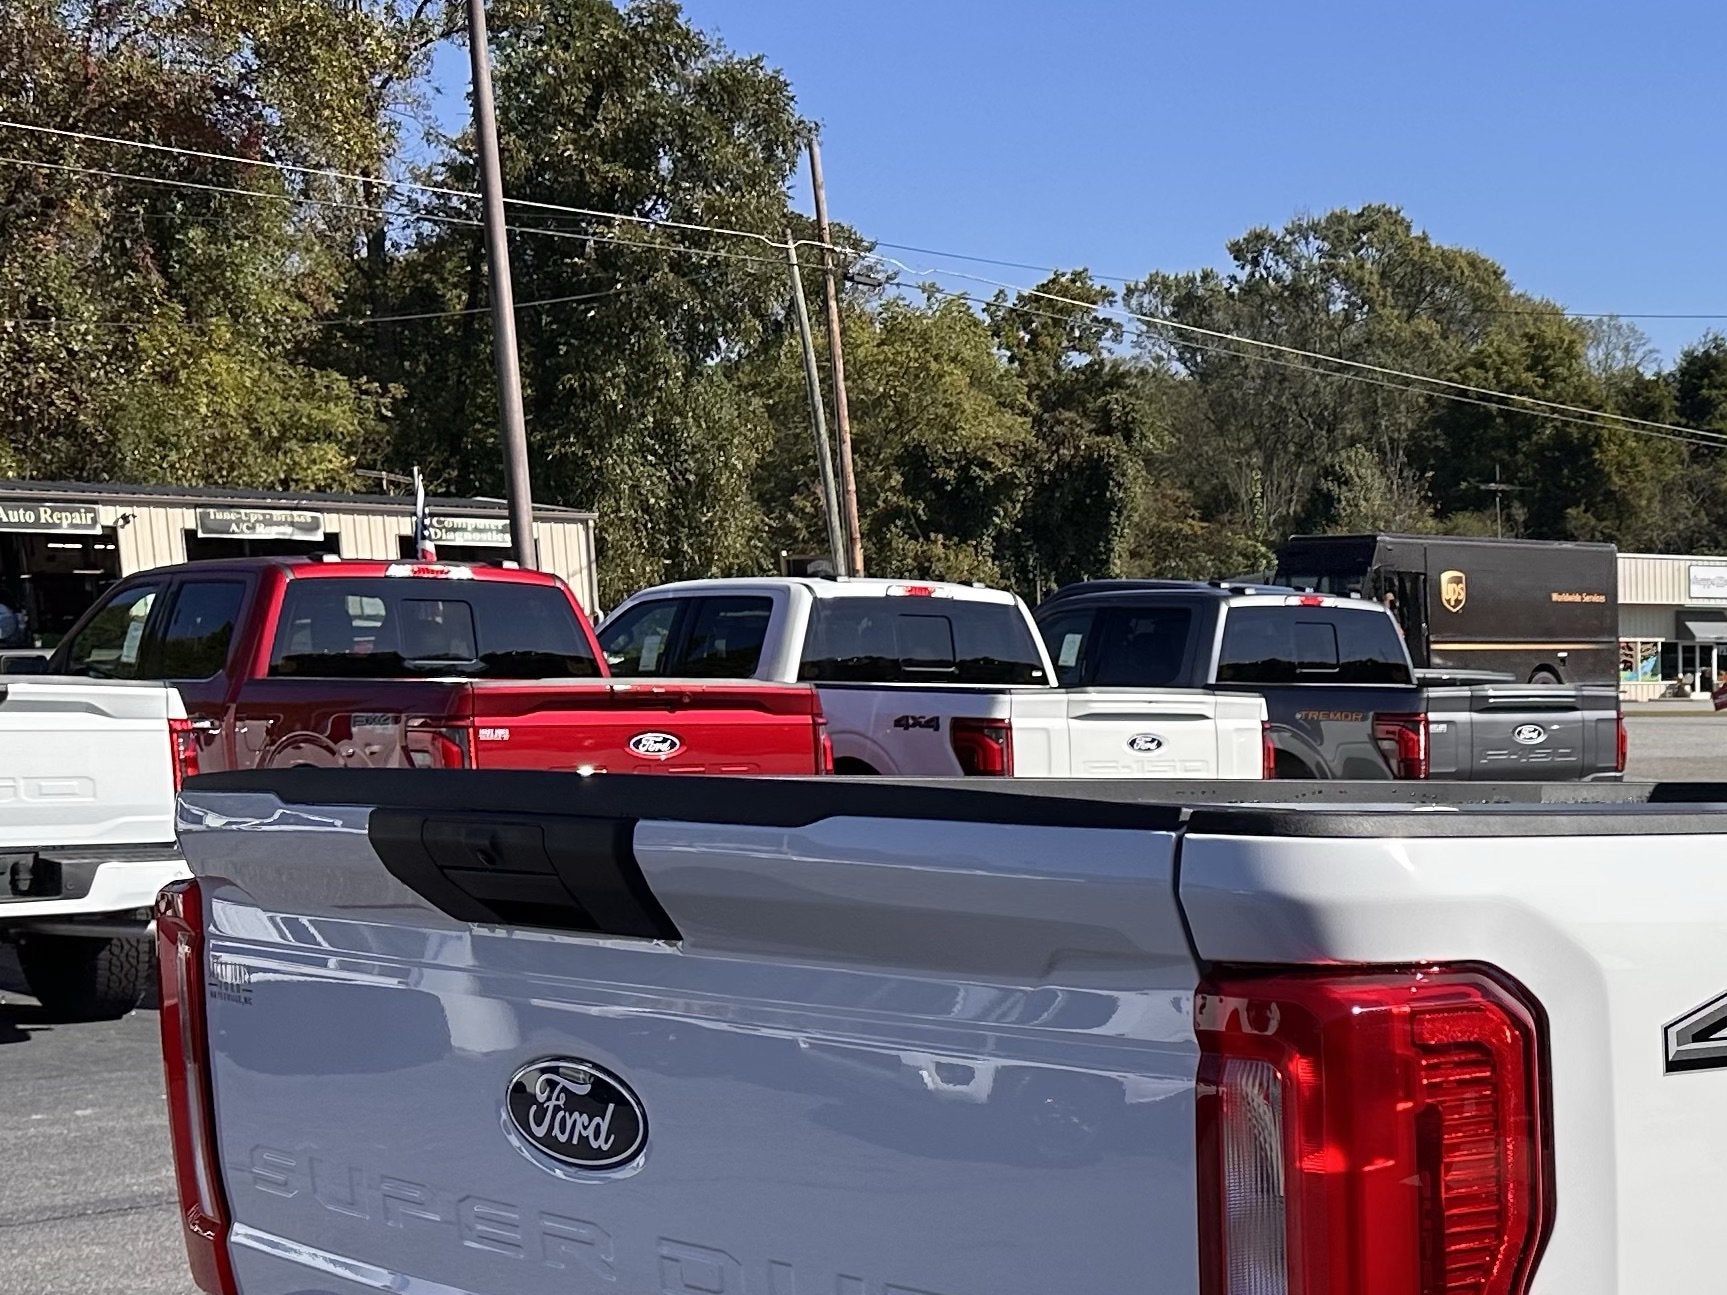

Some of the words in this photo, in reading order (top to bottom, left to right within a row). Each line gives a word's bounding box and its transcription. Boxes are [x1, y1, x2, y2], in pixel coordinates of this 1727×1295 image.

[39, 507, 95, 528] Repair
[432, 517, 504, 530] Computer
[229, 523, 253, 533] A/C
[1300, 711, 1363, 721] TREMOR
[528, 1072, 616, 1152] Ford
[249, 1143, 617, 1283] SUPER
